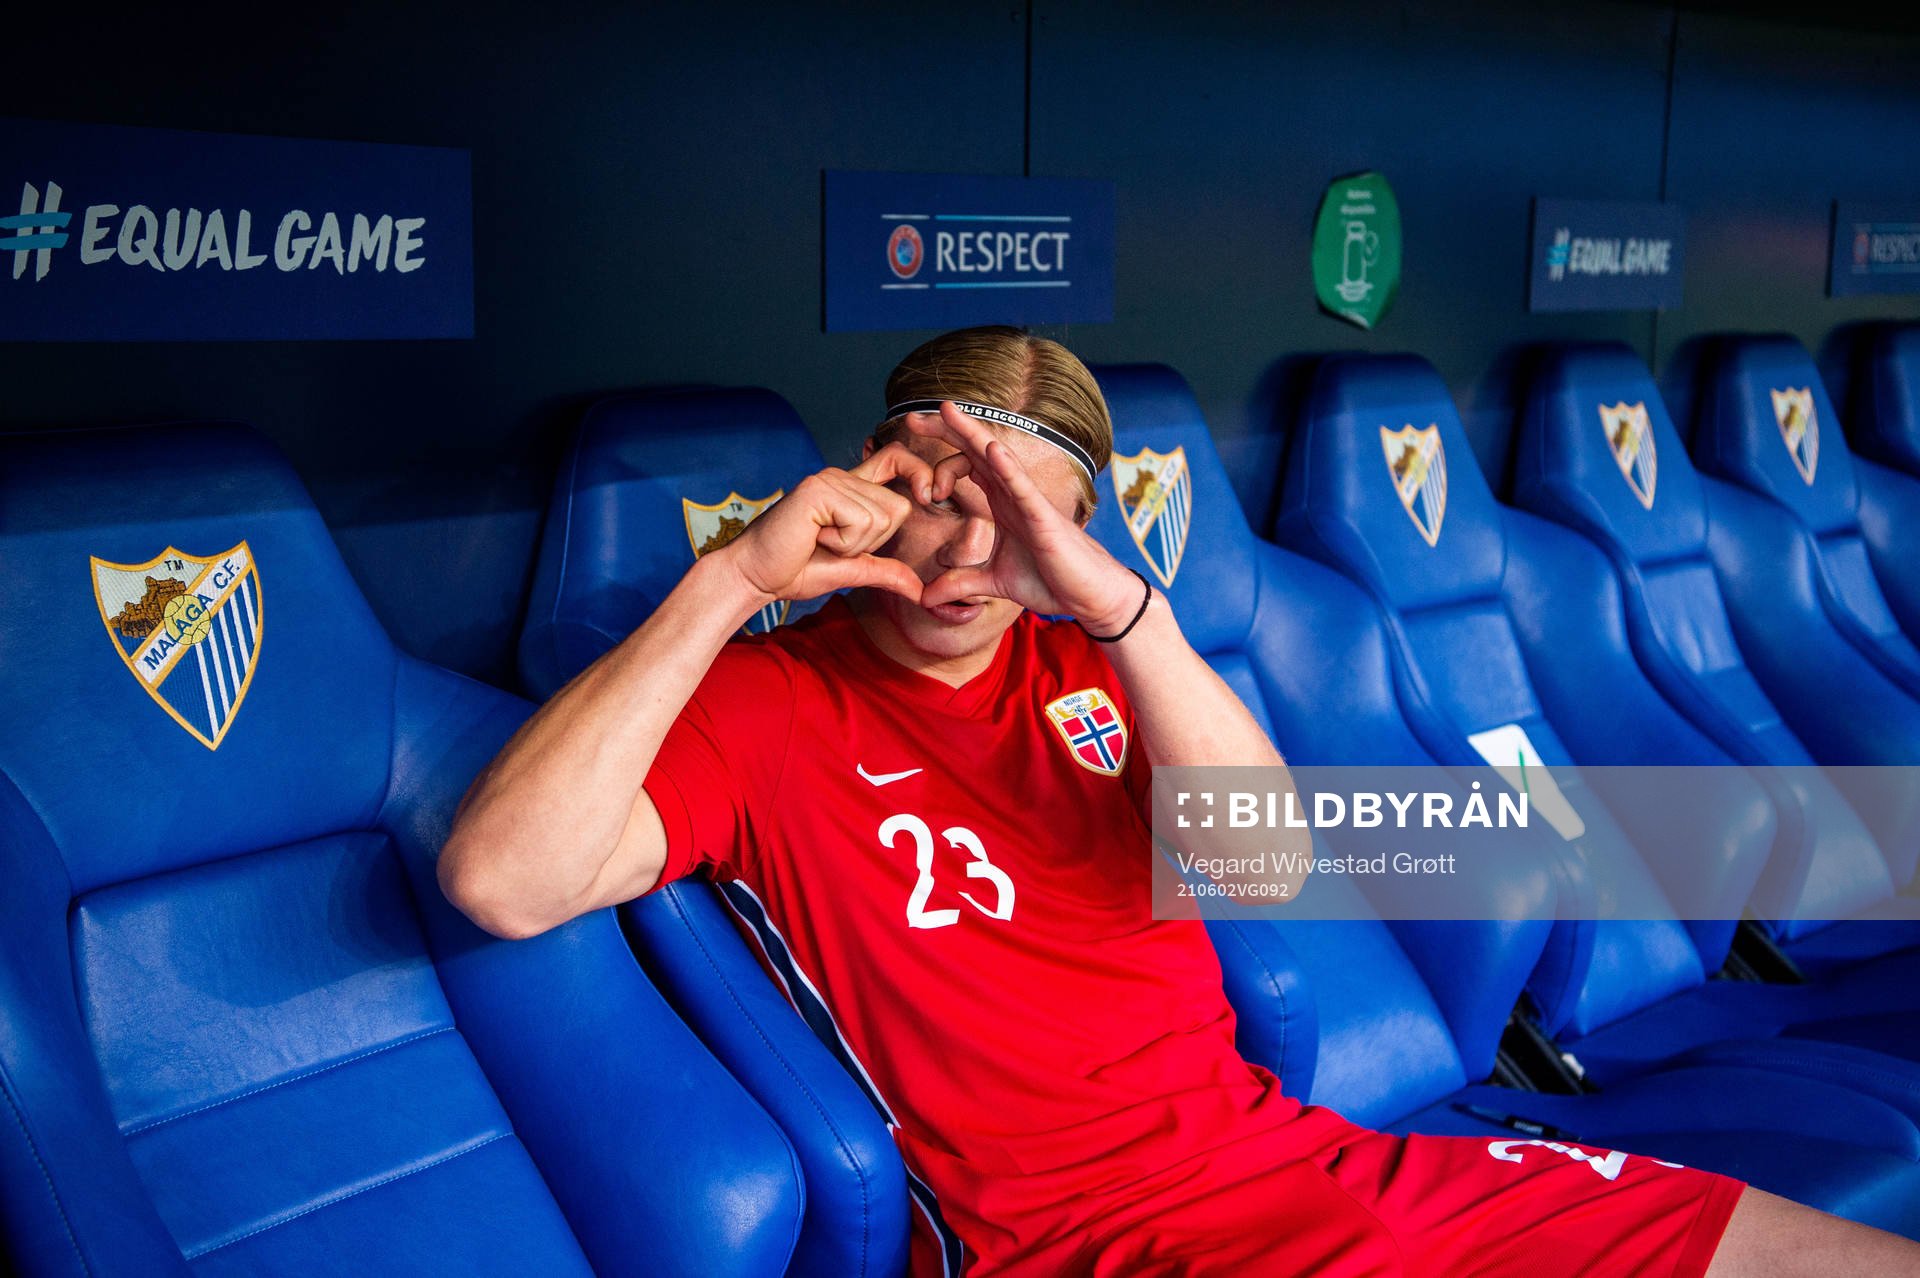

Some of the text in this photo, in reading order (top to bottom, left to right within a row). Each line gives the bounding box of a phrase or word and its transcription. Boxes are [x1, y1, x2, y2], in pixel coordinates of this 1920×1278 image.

[936, 231, 1070, 272] RESPECT
[984, 409, 1039, 432] RECORDS
[164, 560, 184, 571] TM
[877, 813, 1016, 930] 23
